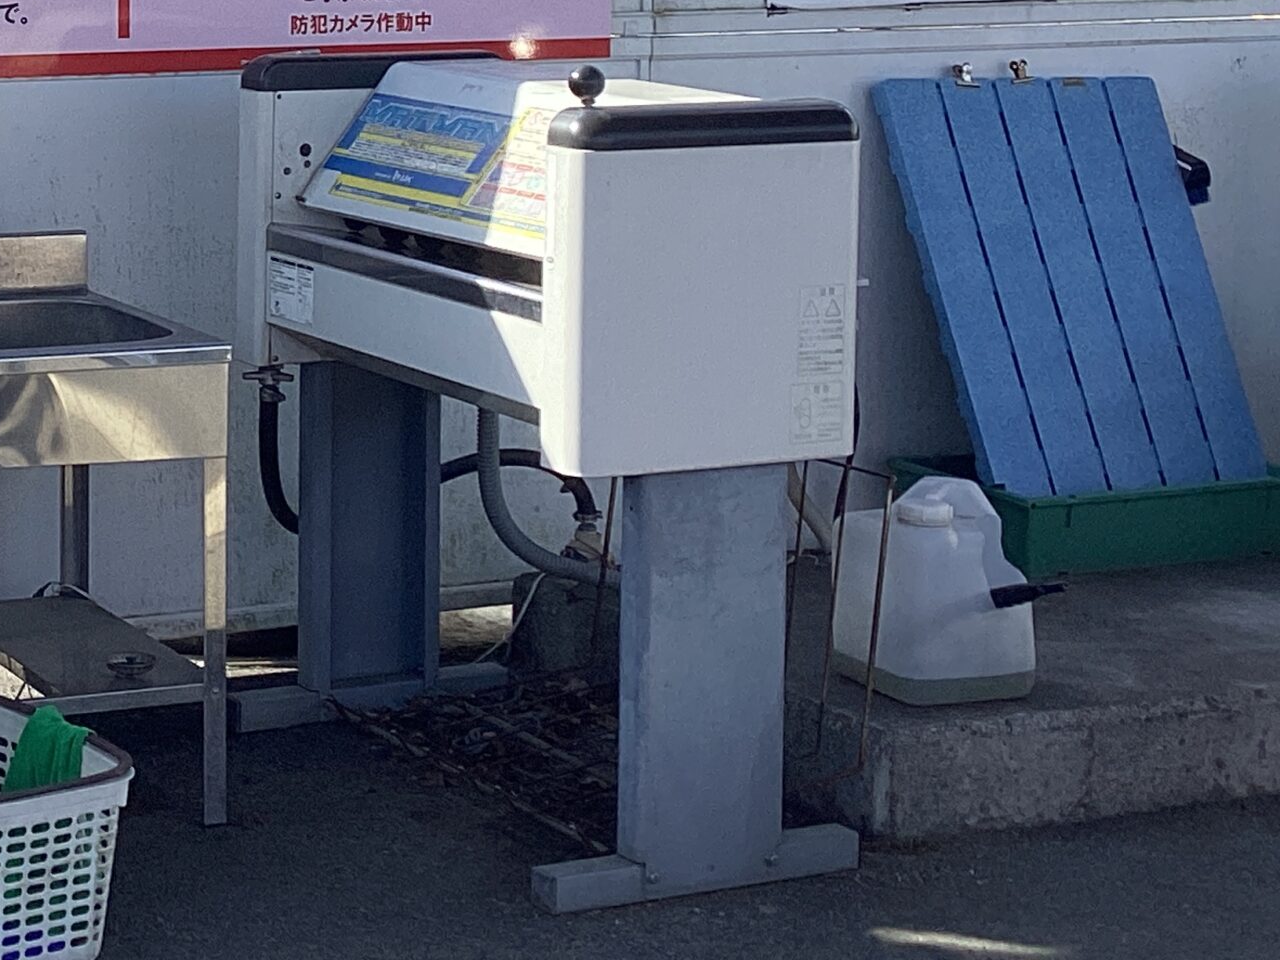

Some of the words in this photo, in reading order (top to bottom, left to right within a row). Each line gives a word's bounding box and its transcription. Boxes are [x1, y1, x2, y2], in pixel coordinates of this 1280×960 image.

[289, 12, 433, 35] 防犯カメラ作動中
